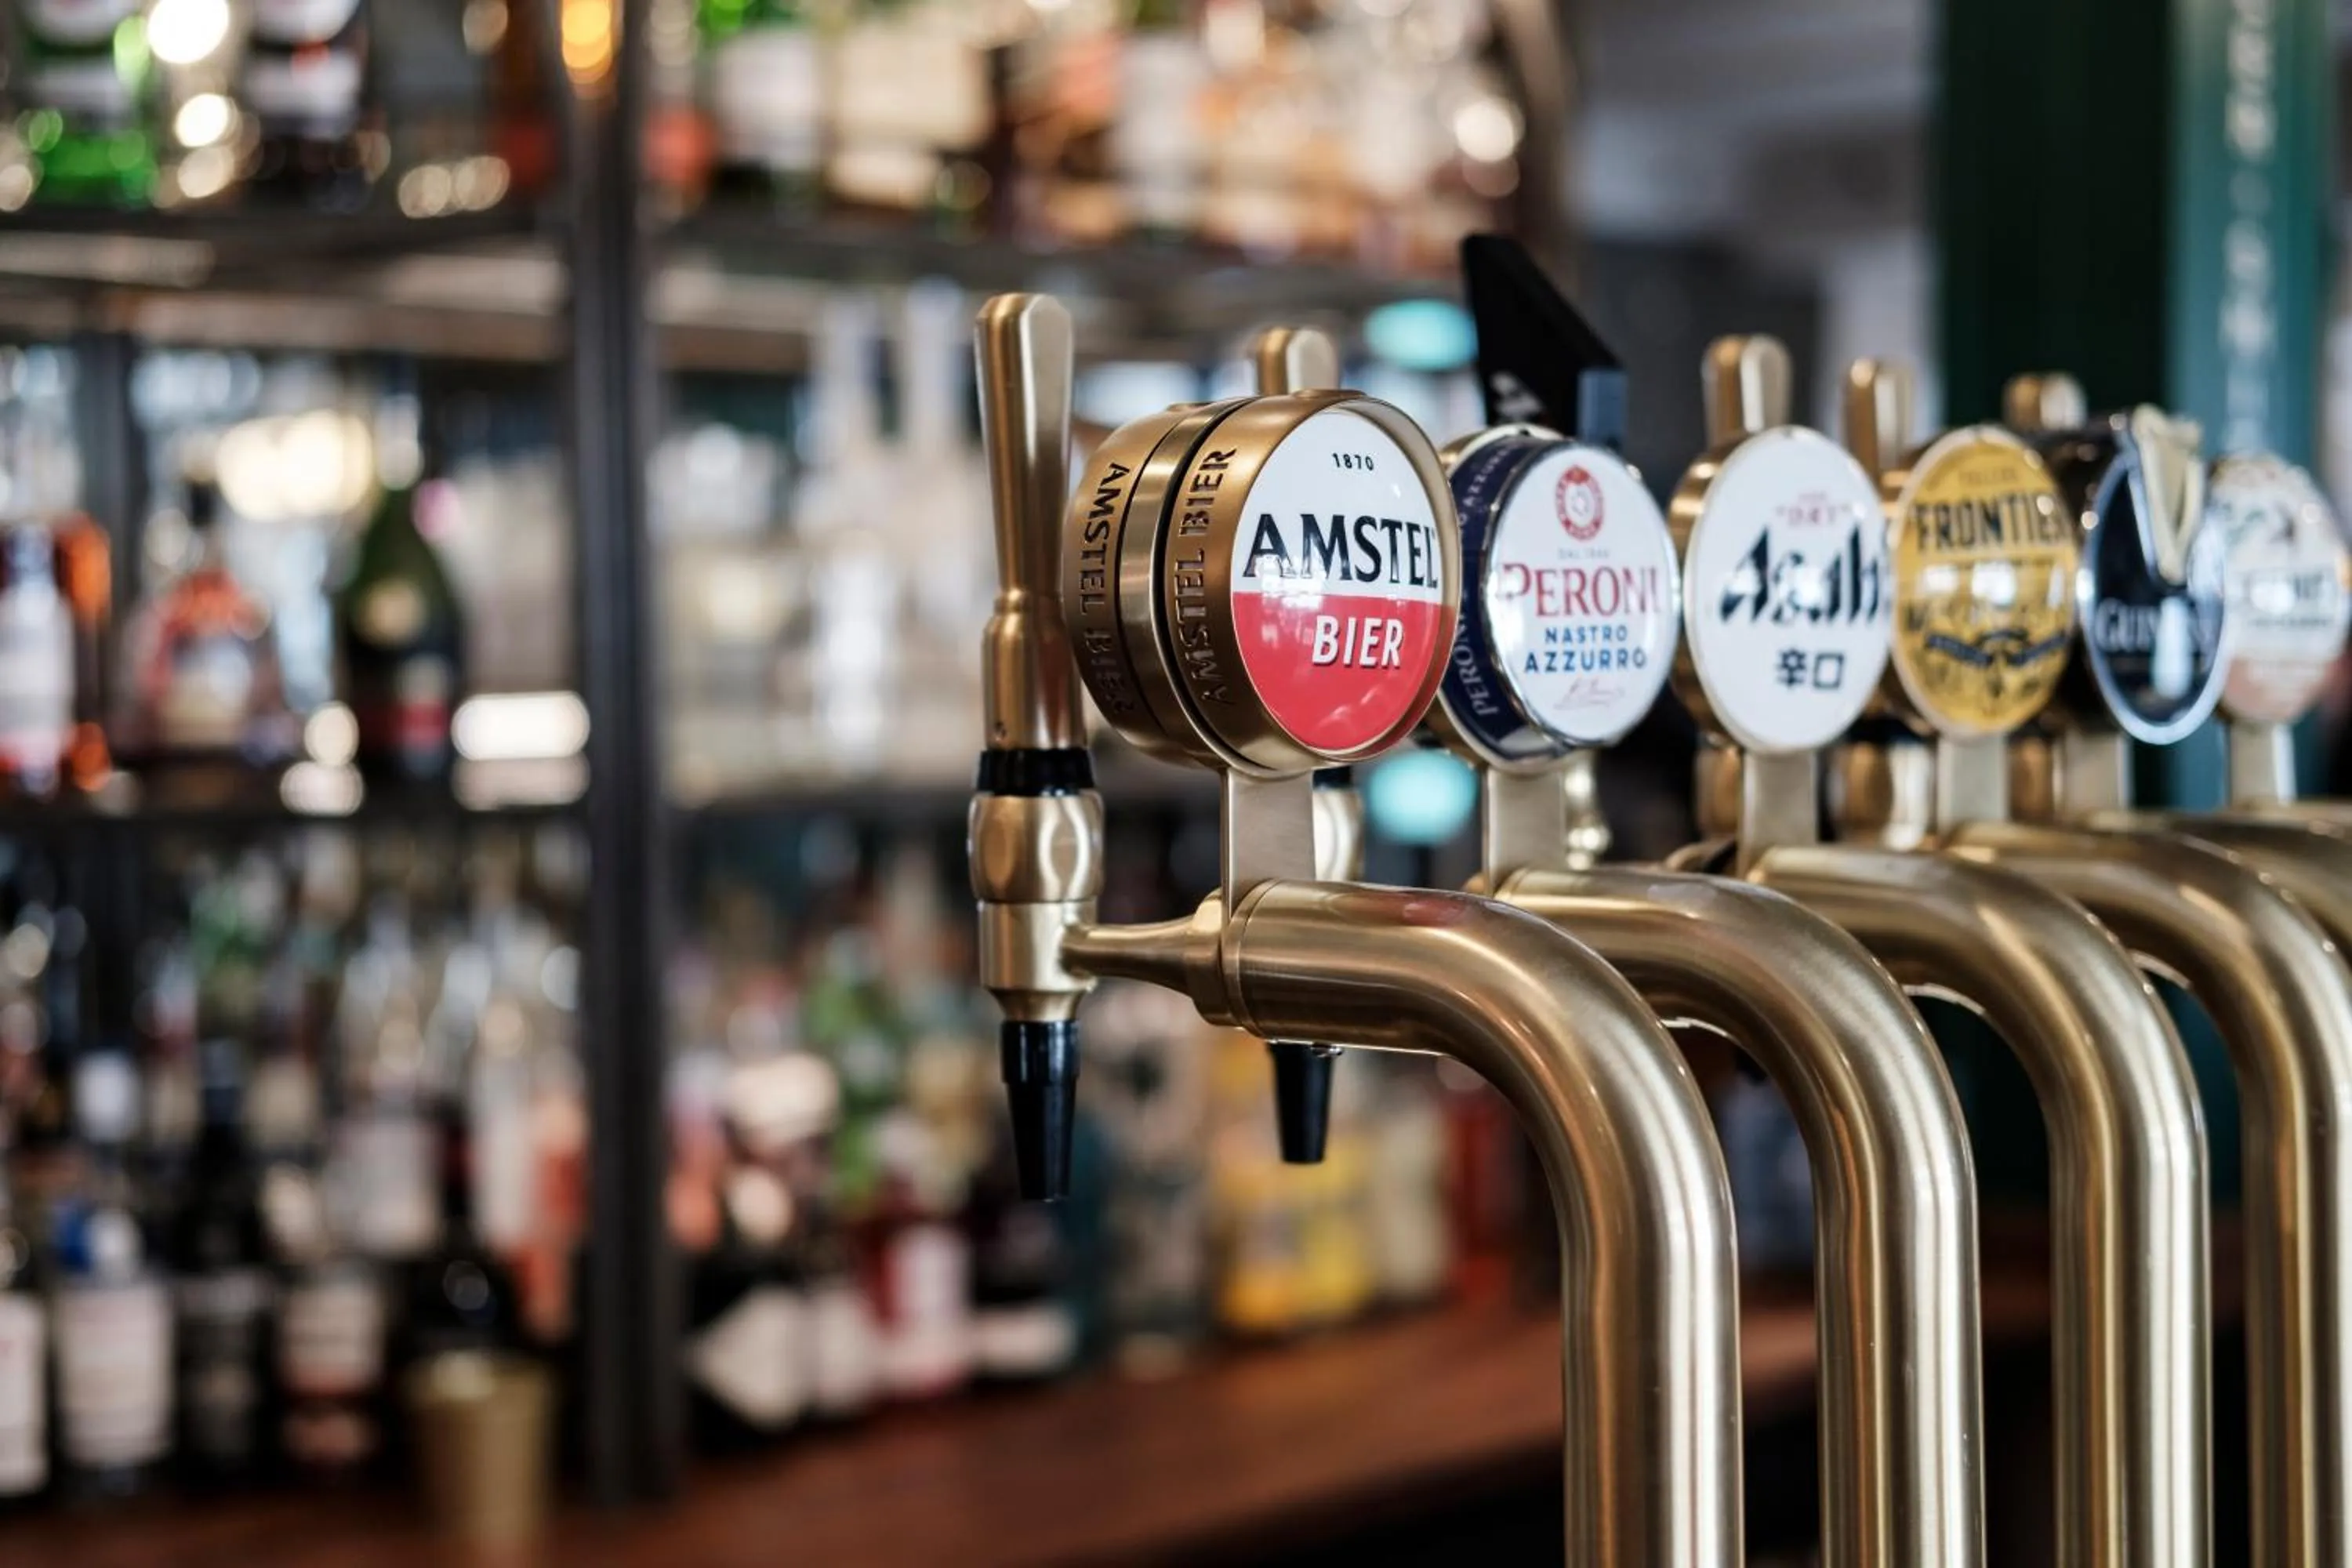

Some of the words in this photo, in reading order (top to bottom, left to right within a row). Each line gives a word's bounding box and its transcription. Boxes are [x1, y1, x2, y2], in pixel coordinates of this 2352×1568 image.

[1332, 452, 1374, 471] 1870
[1178, 448, 1237, 536] BIER
[1079, 463, 1131, 615] AMSTEL
[1242, 514, 1438, 588] AMSTEL
[1496, 563, 1660, 617] PERONI
[1174, 548, 1233, 705] AMSTEL
[1311, 615, 1403, 668] BIER
[1545, 625, 1628, 643] NASTRO
[1524, 651, 1646, 673] AZZURRO
